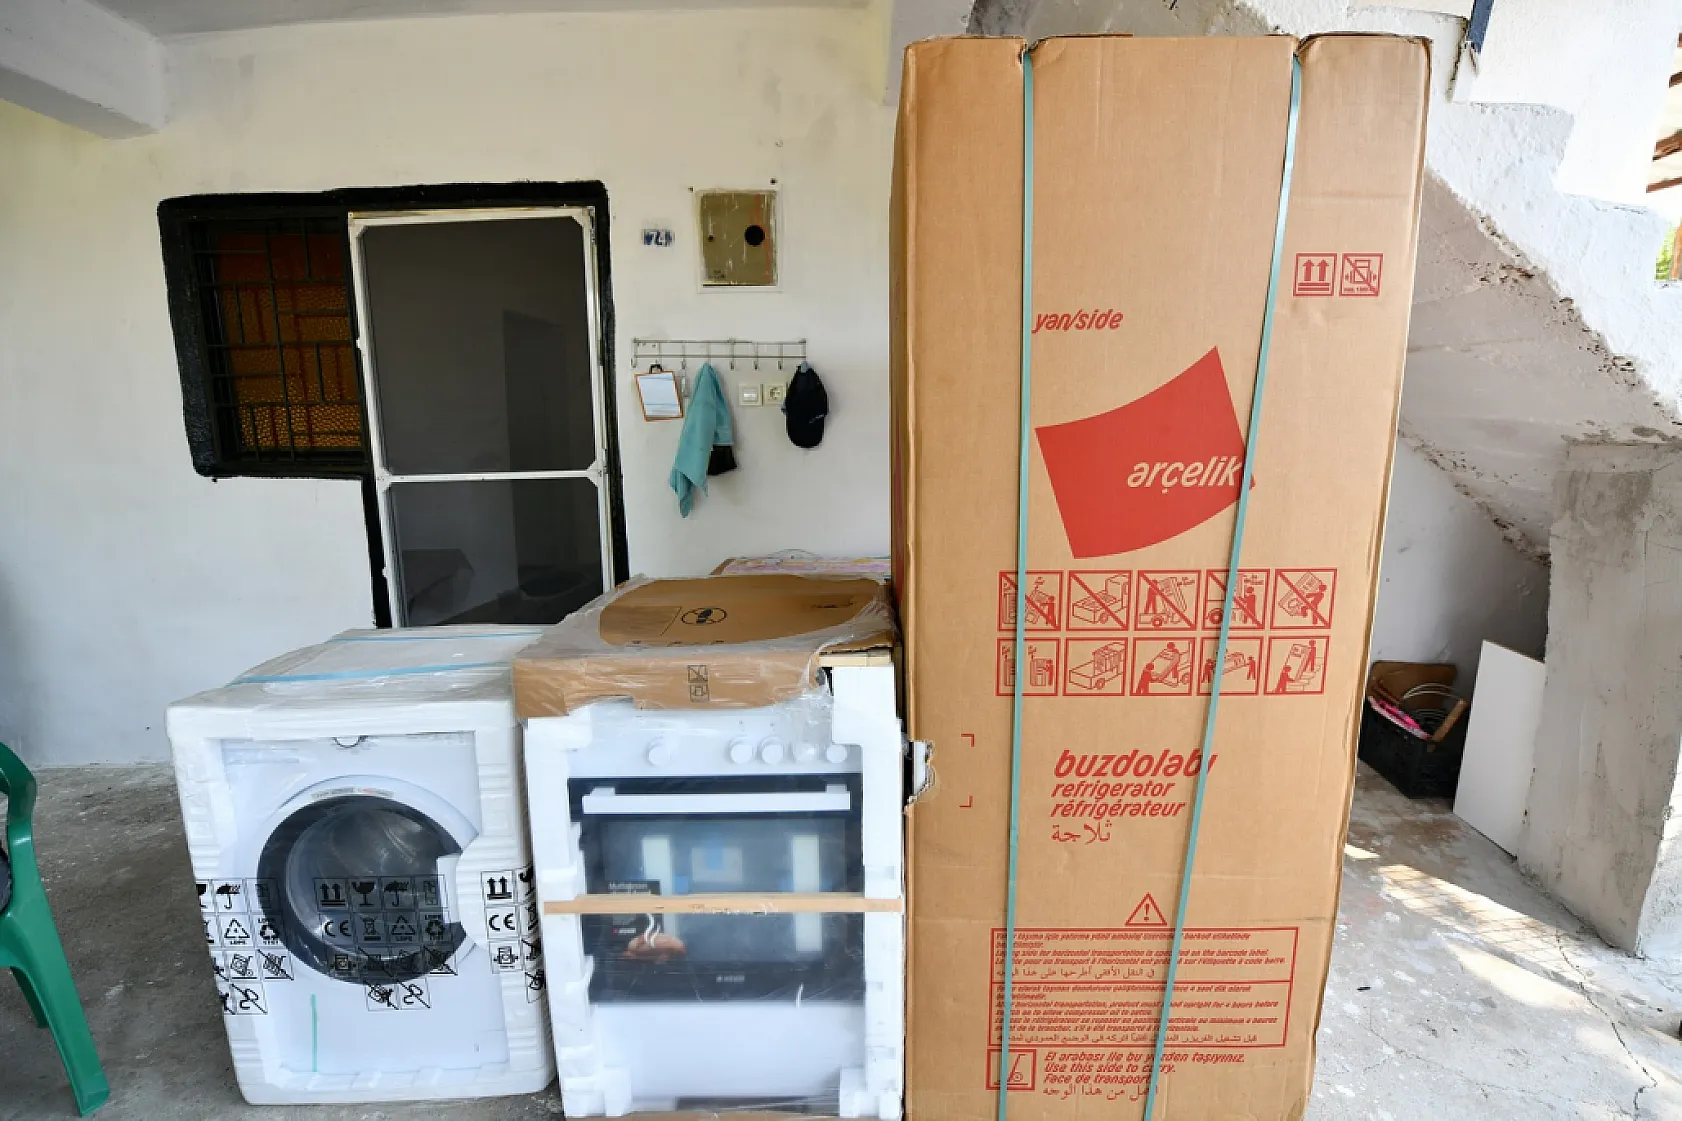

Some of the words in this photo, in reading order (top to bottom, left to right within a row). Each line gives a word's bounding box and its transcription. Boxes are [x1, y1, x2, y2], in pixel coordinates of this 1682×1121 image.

[1031, 309, 1124, 334] yan/side
[1127, 456, 1244, 493] arçelik
[1053, 748, 1218, 778] buzdolabı
[1050, 780, 1175, 800] refrigerator
[1050, 799, 1187, 820] réfrigérateur
[1051, 819, 1112, 845] ثلاجة
[1044, 1051, 1057, 1062] El
[1058, 1051, 1105, 1062] arabası
[1107, 1052, 1124, 1062] ile
[1126, 1052, 1143, 1062] bu
[1145, 1052, 1187, 1064] yrden
[1044, 1062, 1068, 1073] Use
[1070, 1062, 1093, 1073] this
[1096, 1062, 1124, 1073] side
[1126, 1063, 1141, 1073] to
[1043, 1073, 1071, 1084] Face
[1075, 1073, 1090, 1084] de
[1081, 1084, 1102, 1096] هذا
[1106, 1088, 1125, 1101] من
